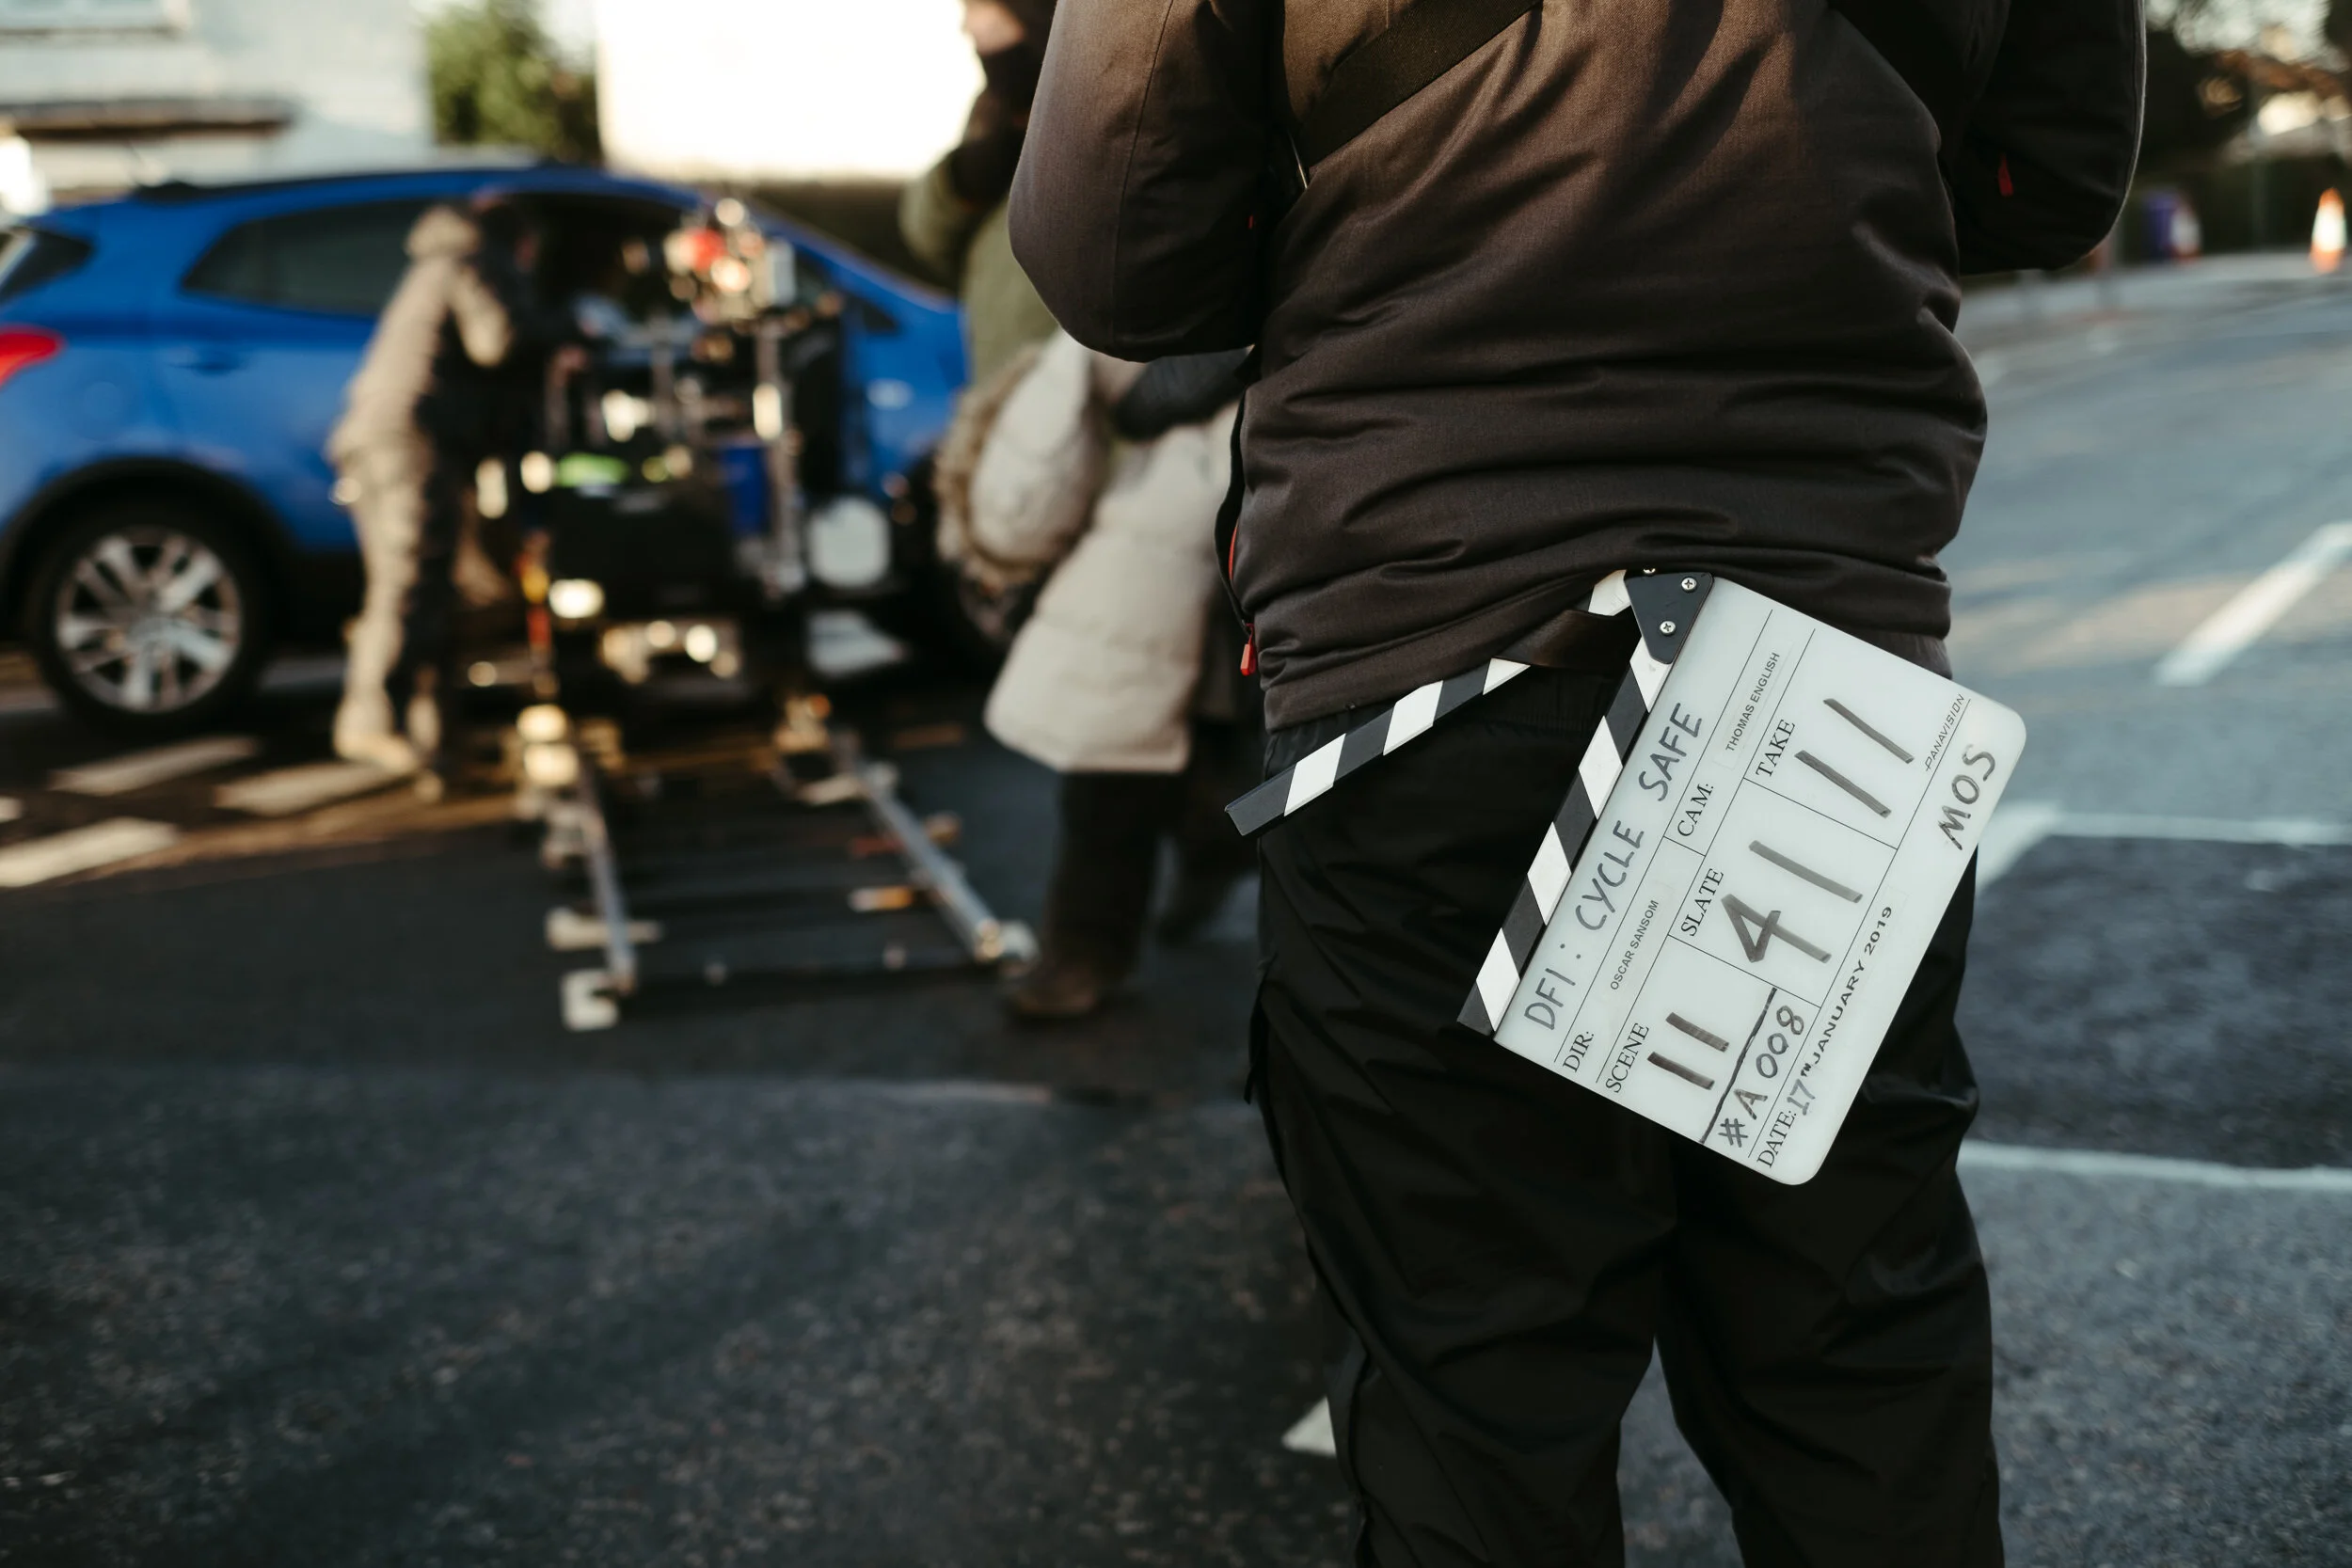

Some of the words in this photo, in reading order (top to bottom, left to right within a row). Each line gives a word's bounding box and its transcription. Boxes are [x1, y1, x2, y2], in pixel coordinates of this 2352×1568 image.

[1725, 704, 1755, 753] THOMAS
[1750, 652, 1780, 703] ENGLISH
[1926, 693, 1964, 772] PANAVISION
[1755, 719, 1795, 777] TAKE
[1575, 820, 1644, 930] CYCLE
[1638, 703, 1702, 801] SAFE
[1677, 783, 1713, 837] CAM:
[1937, 744, 1995, 850] MOS
[1681, 868, 1724, 936] SLATE
[1610, 951, 1634, 990] OSCAR
[1630, 900, 1659, 949] SANSOM
[1563, 1030, 1594, 1072] DIR:
[1605, 1022, 1649, 1093] SCENE
[1756, 1110, 1797, 1168] DATE:
[1811, 960, 1865, 1065] JANUARY
[1864, 906, 1892, 956] 2019
[1756, 1005, 1804, 1078] 008
